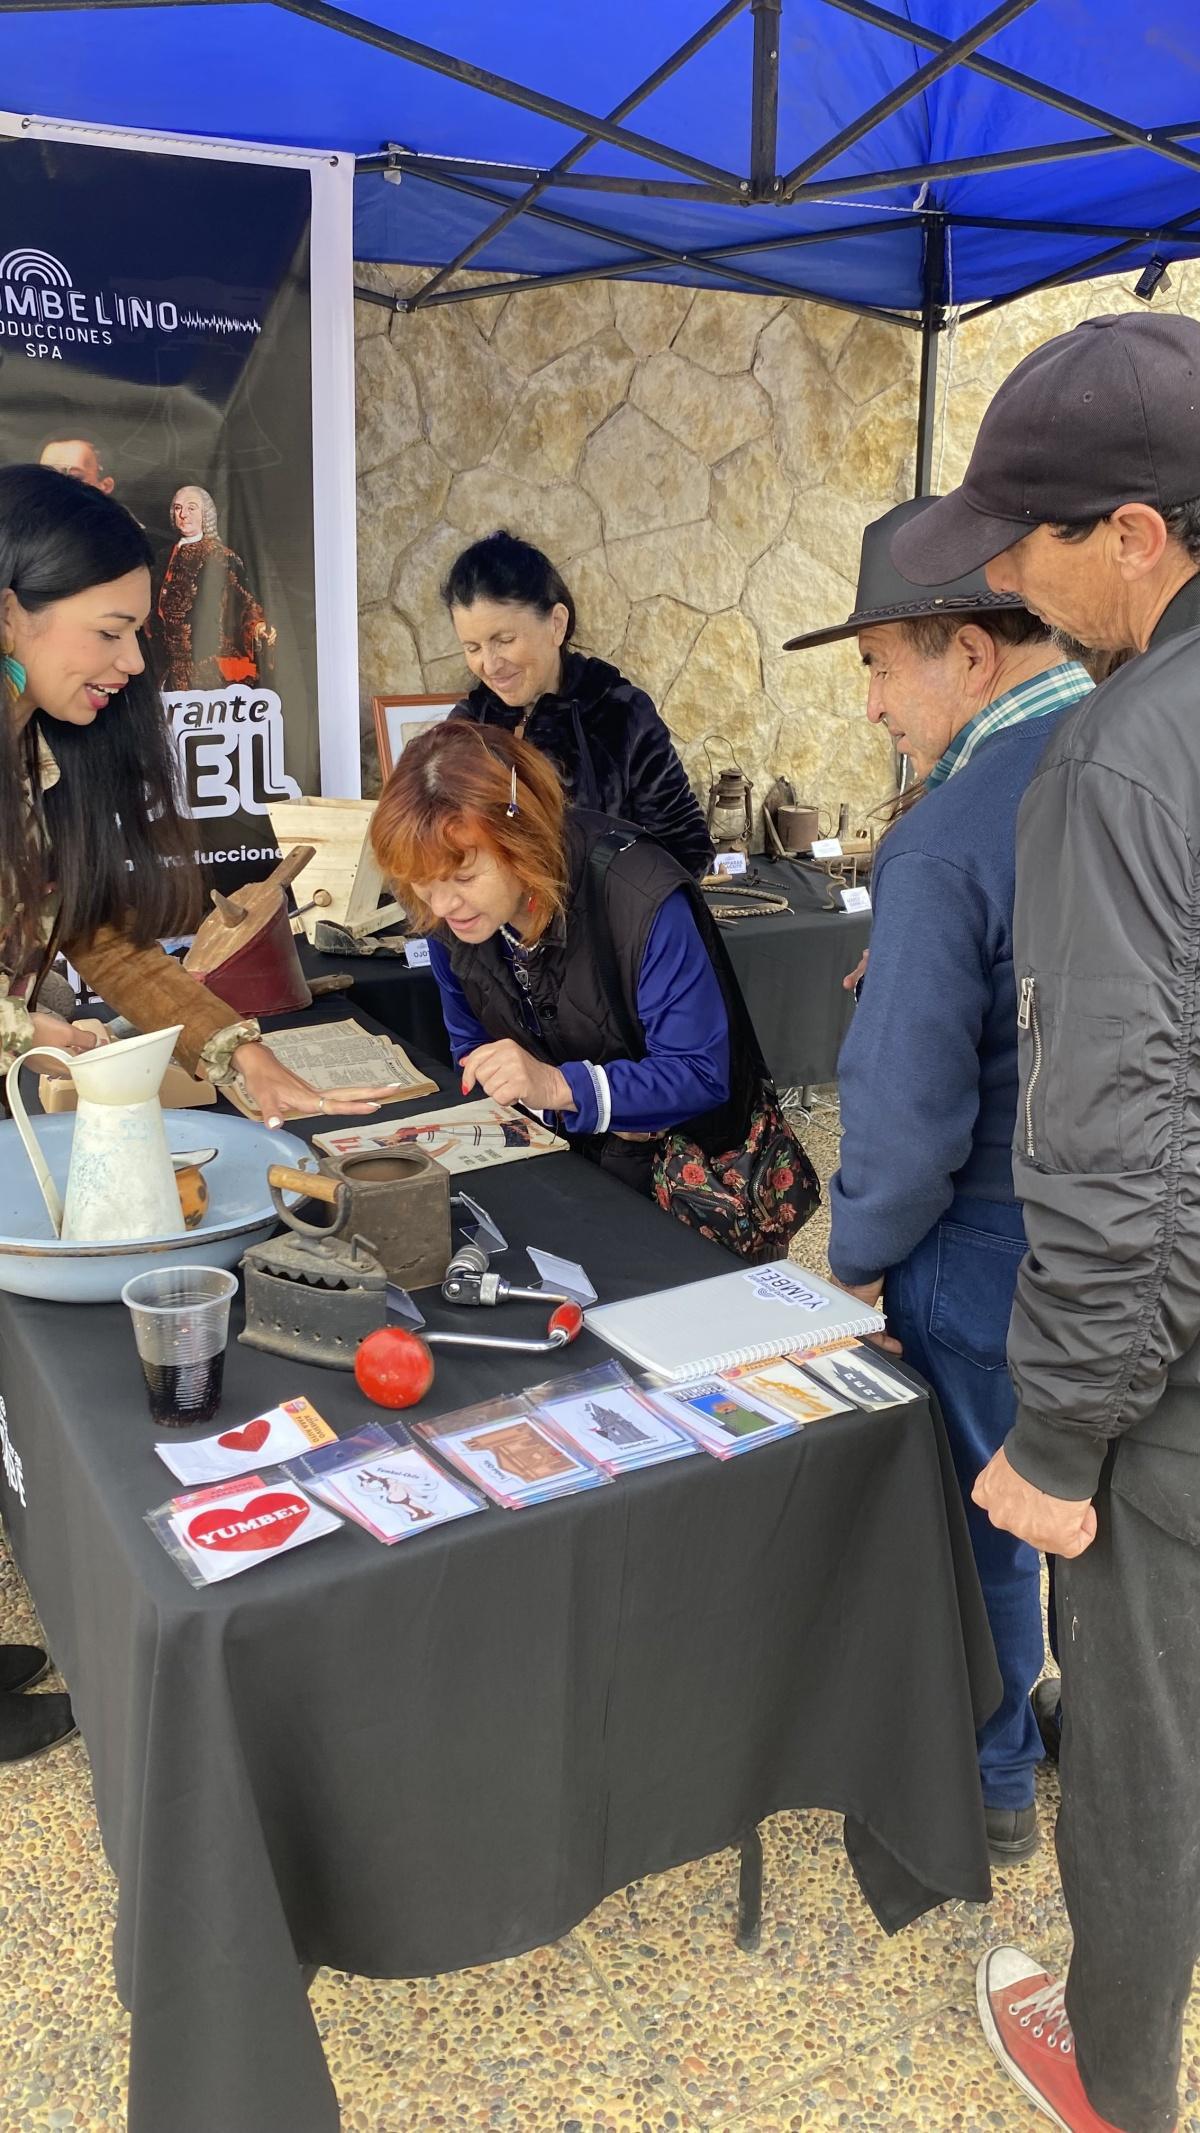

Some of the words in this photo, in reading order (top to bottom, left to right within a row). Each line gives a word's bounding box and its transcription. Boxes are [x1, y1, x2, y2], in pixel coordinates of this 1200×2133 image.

[0, 285, 178, 331] MBELINO
[25, 342, 63, 360] SPA
[755, 1268, 824, 1309] YUMBEL
[196, 1504, 308, 1545] YUMBEL
